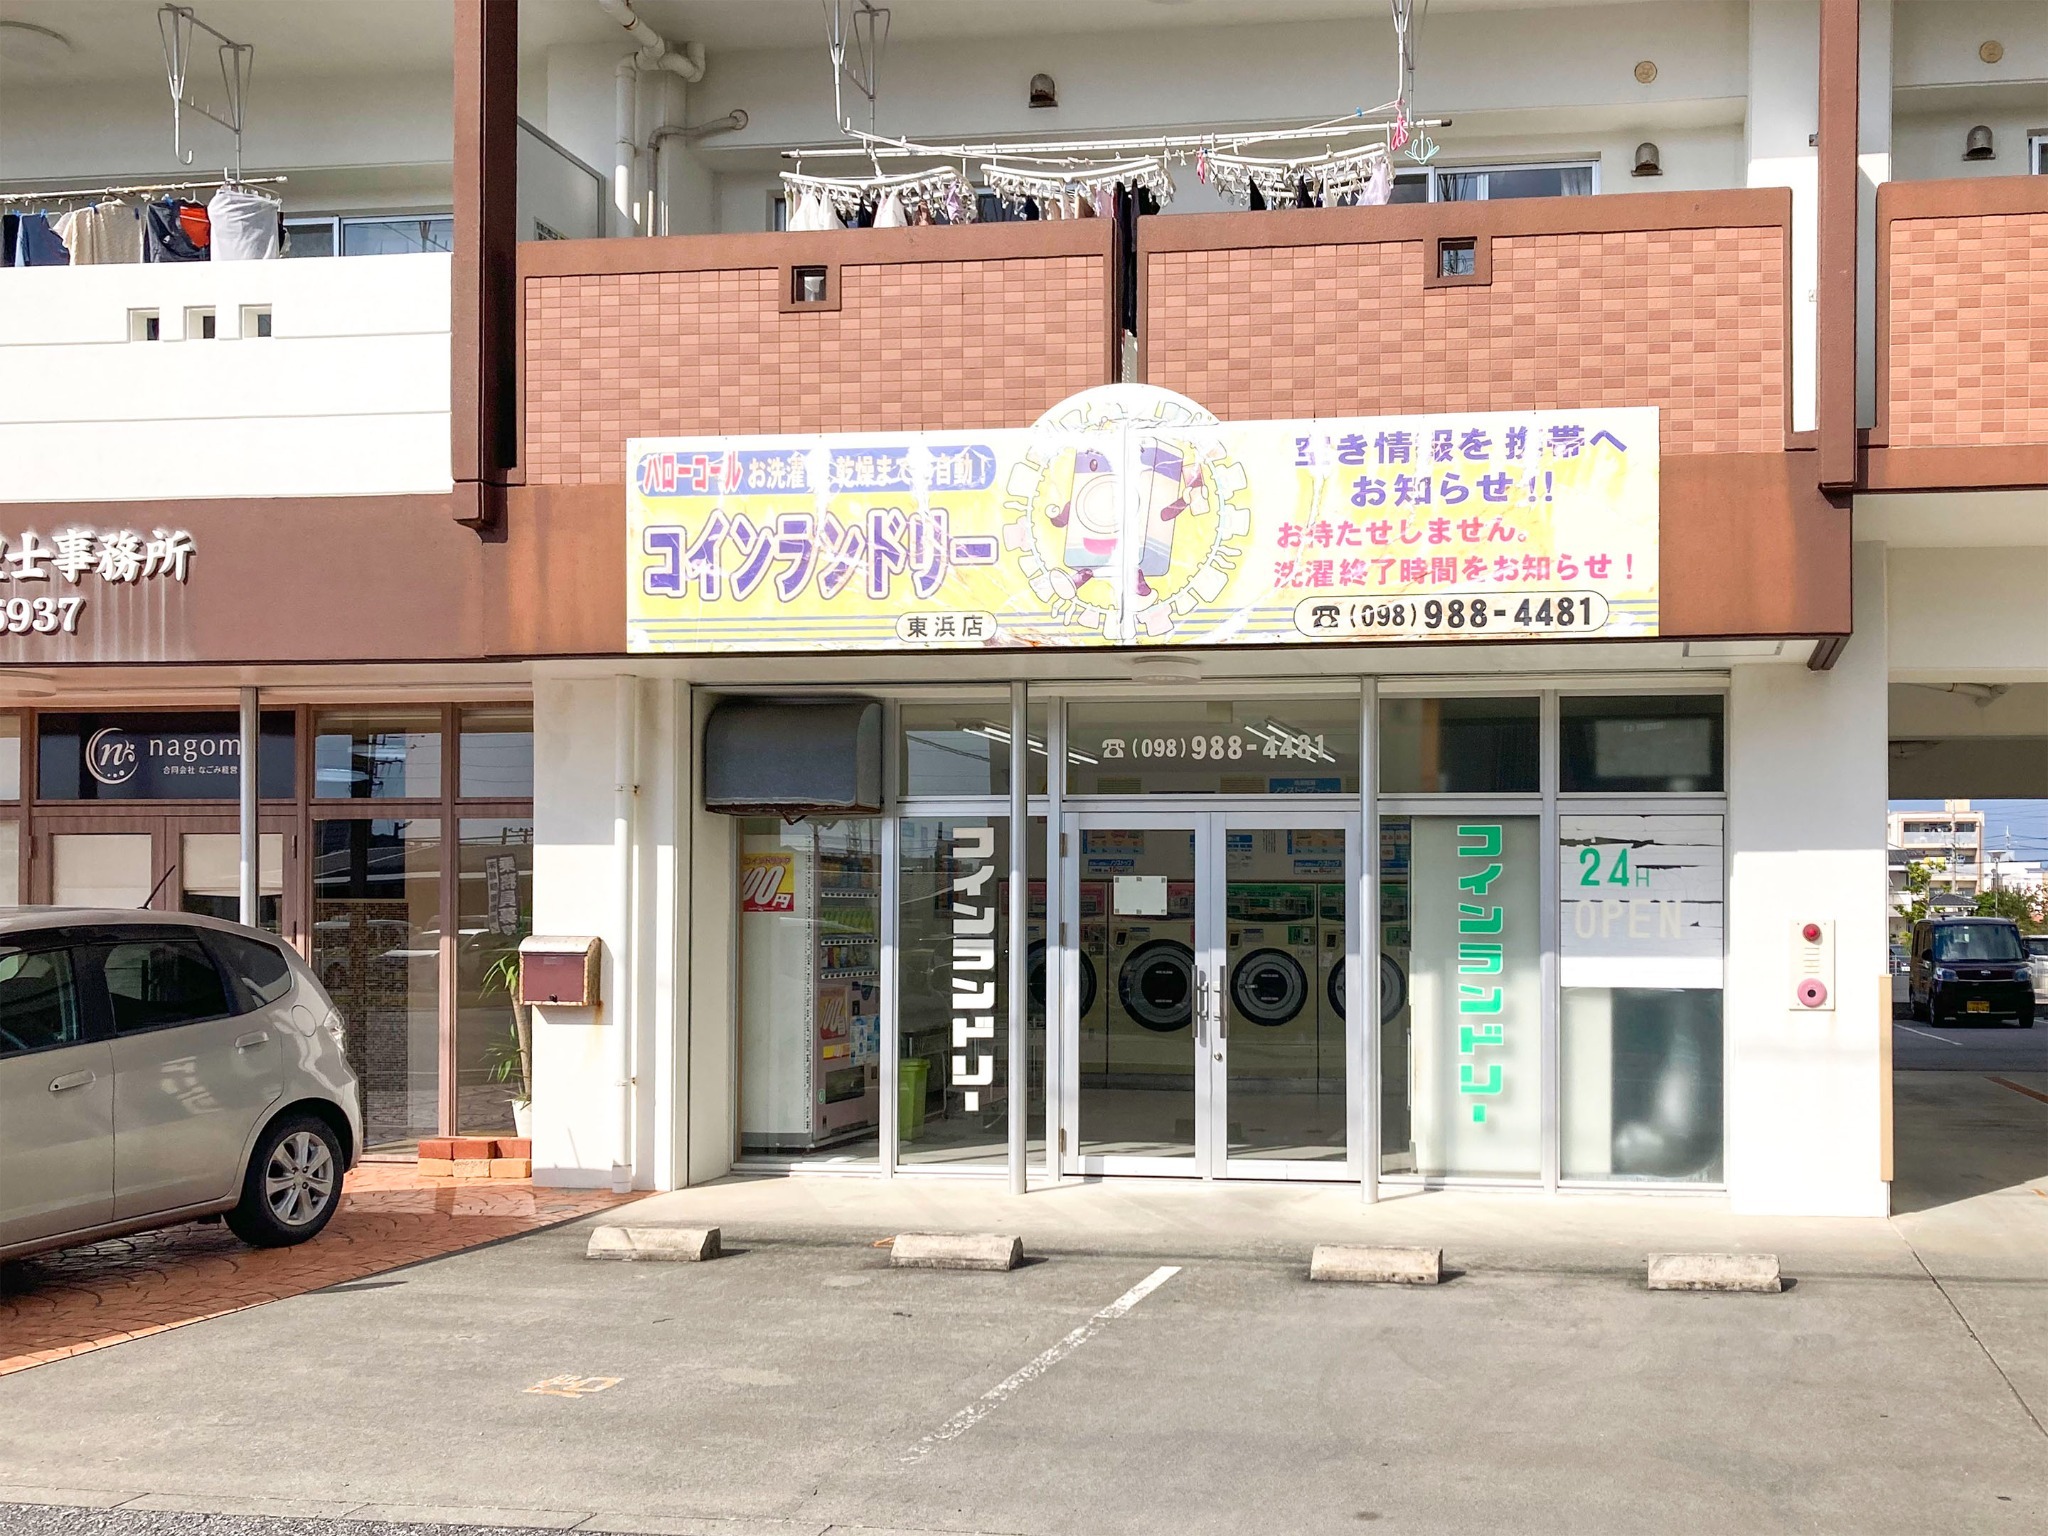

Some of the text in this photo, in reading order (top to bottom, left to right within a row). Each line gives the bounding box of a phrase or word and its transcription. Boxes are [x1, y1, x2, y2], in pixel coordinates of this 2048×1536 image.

[1276, 516, 1527, 549] お待たせしません。
[0, 528, 194, 583] 士事務所
[643, 507, 999, 602] コインランドリー
[1273, 552, 1634, 589] 洗濯終了時間をお知らせ！
[0, 597, 85, 633] 937
[906, 615, 984, 638] 東浜店
[1349, 597, 1591, 630] (098)988-4481
[1132, 734, 1325, 760] (098)988-4481
[1574, 900, 1683, 939] OPEN
[952, 827, 995, 1112] コインランドリー
[1457, 824, 1504, 1123] コインランドリー
